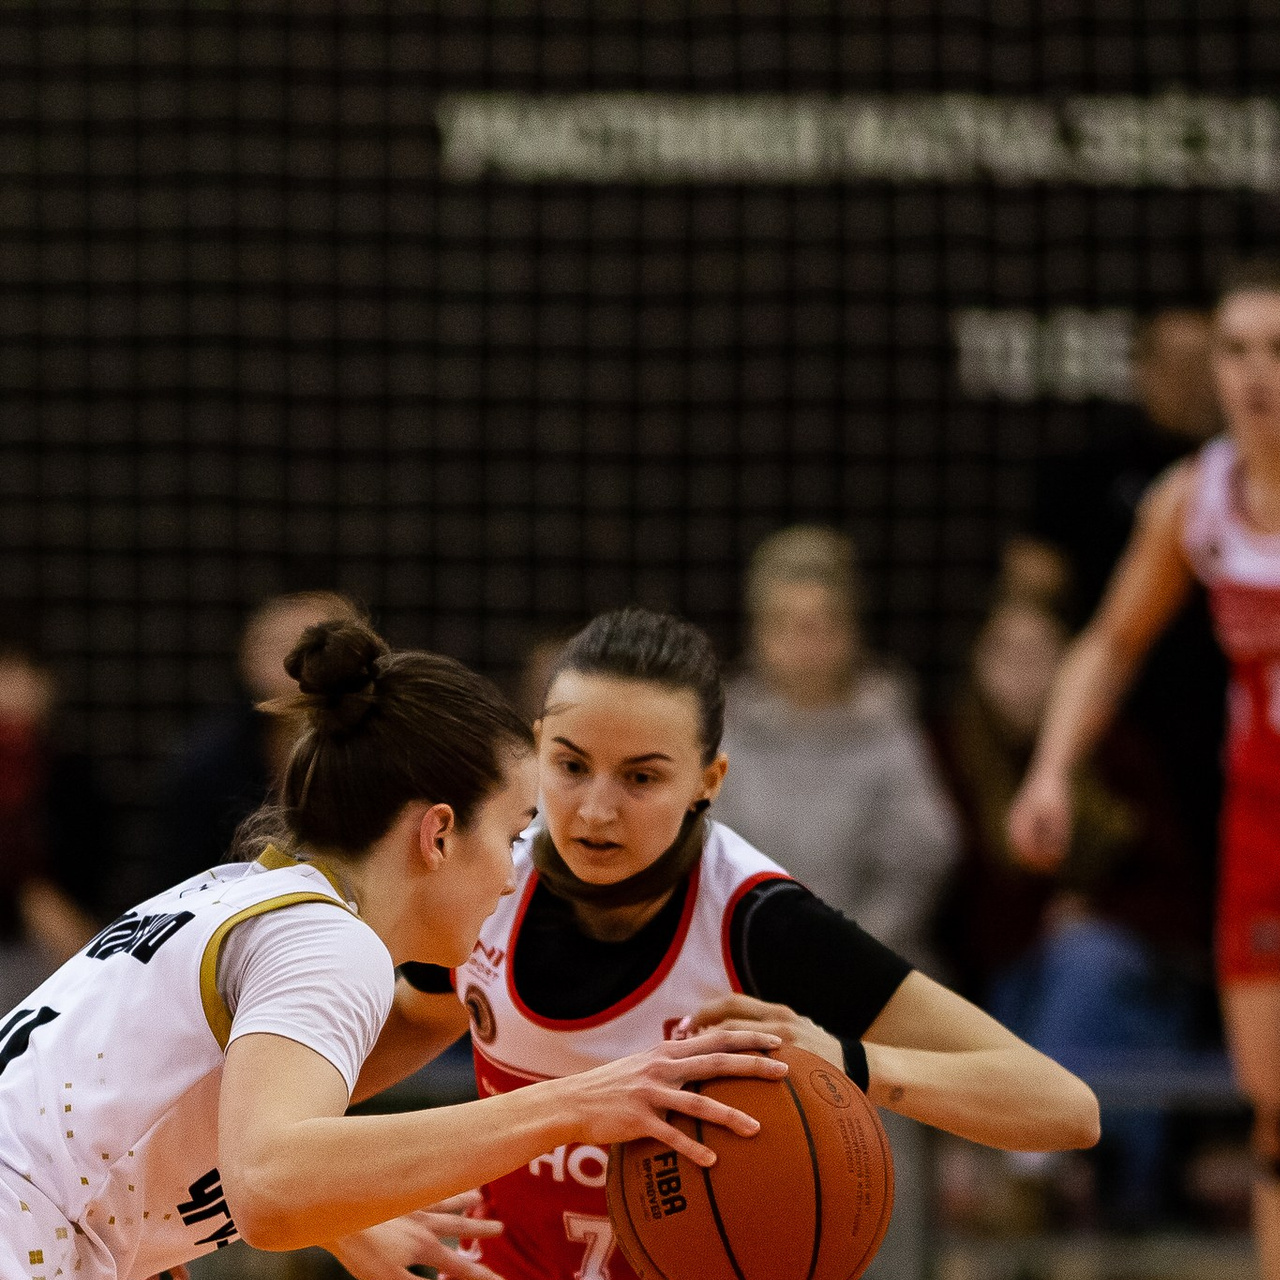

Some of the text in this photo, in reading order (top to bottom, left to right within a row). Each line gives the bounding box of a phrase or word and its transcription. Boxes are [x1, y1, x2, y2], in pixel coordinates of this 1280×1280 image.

[529, 1143, 609, 1188] НО
[642, 1157, 662, 1220] APPROVED
[654, 1149, 687, 1216] FIBA
